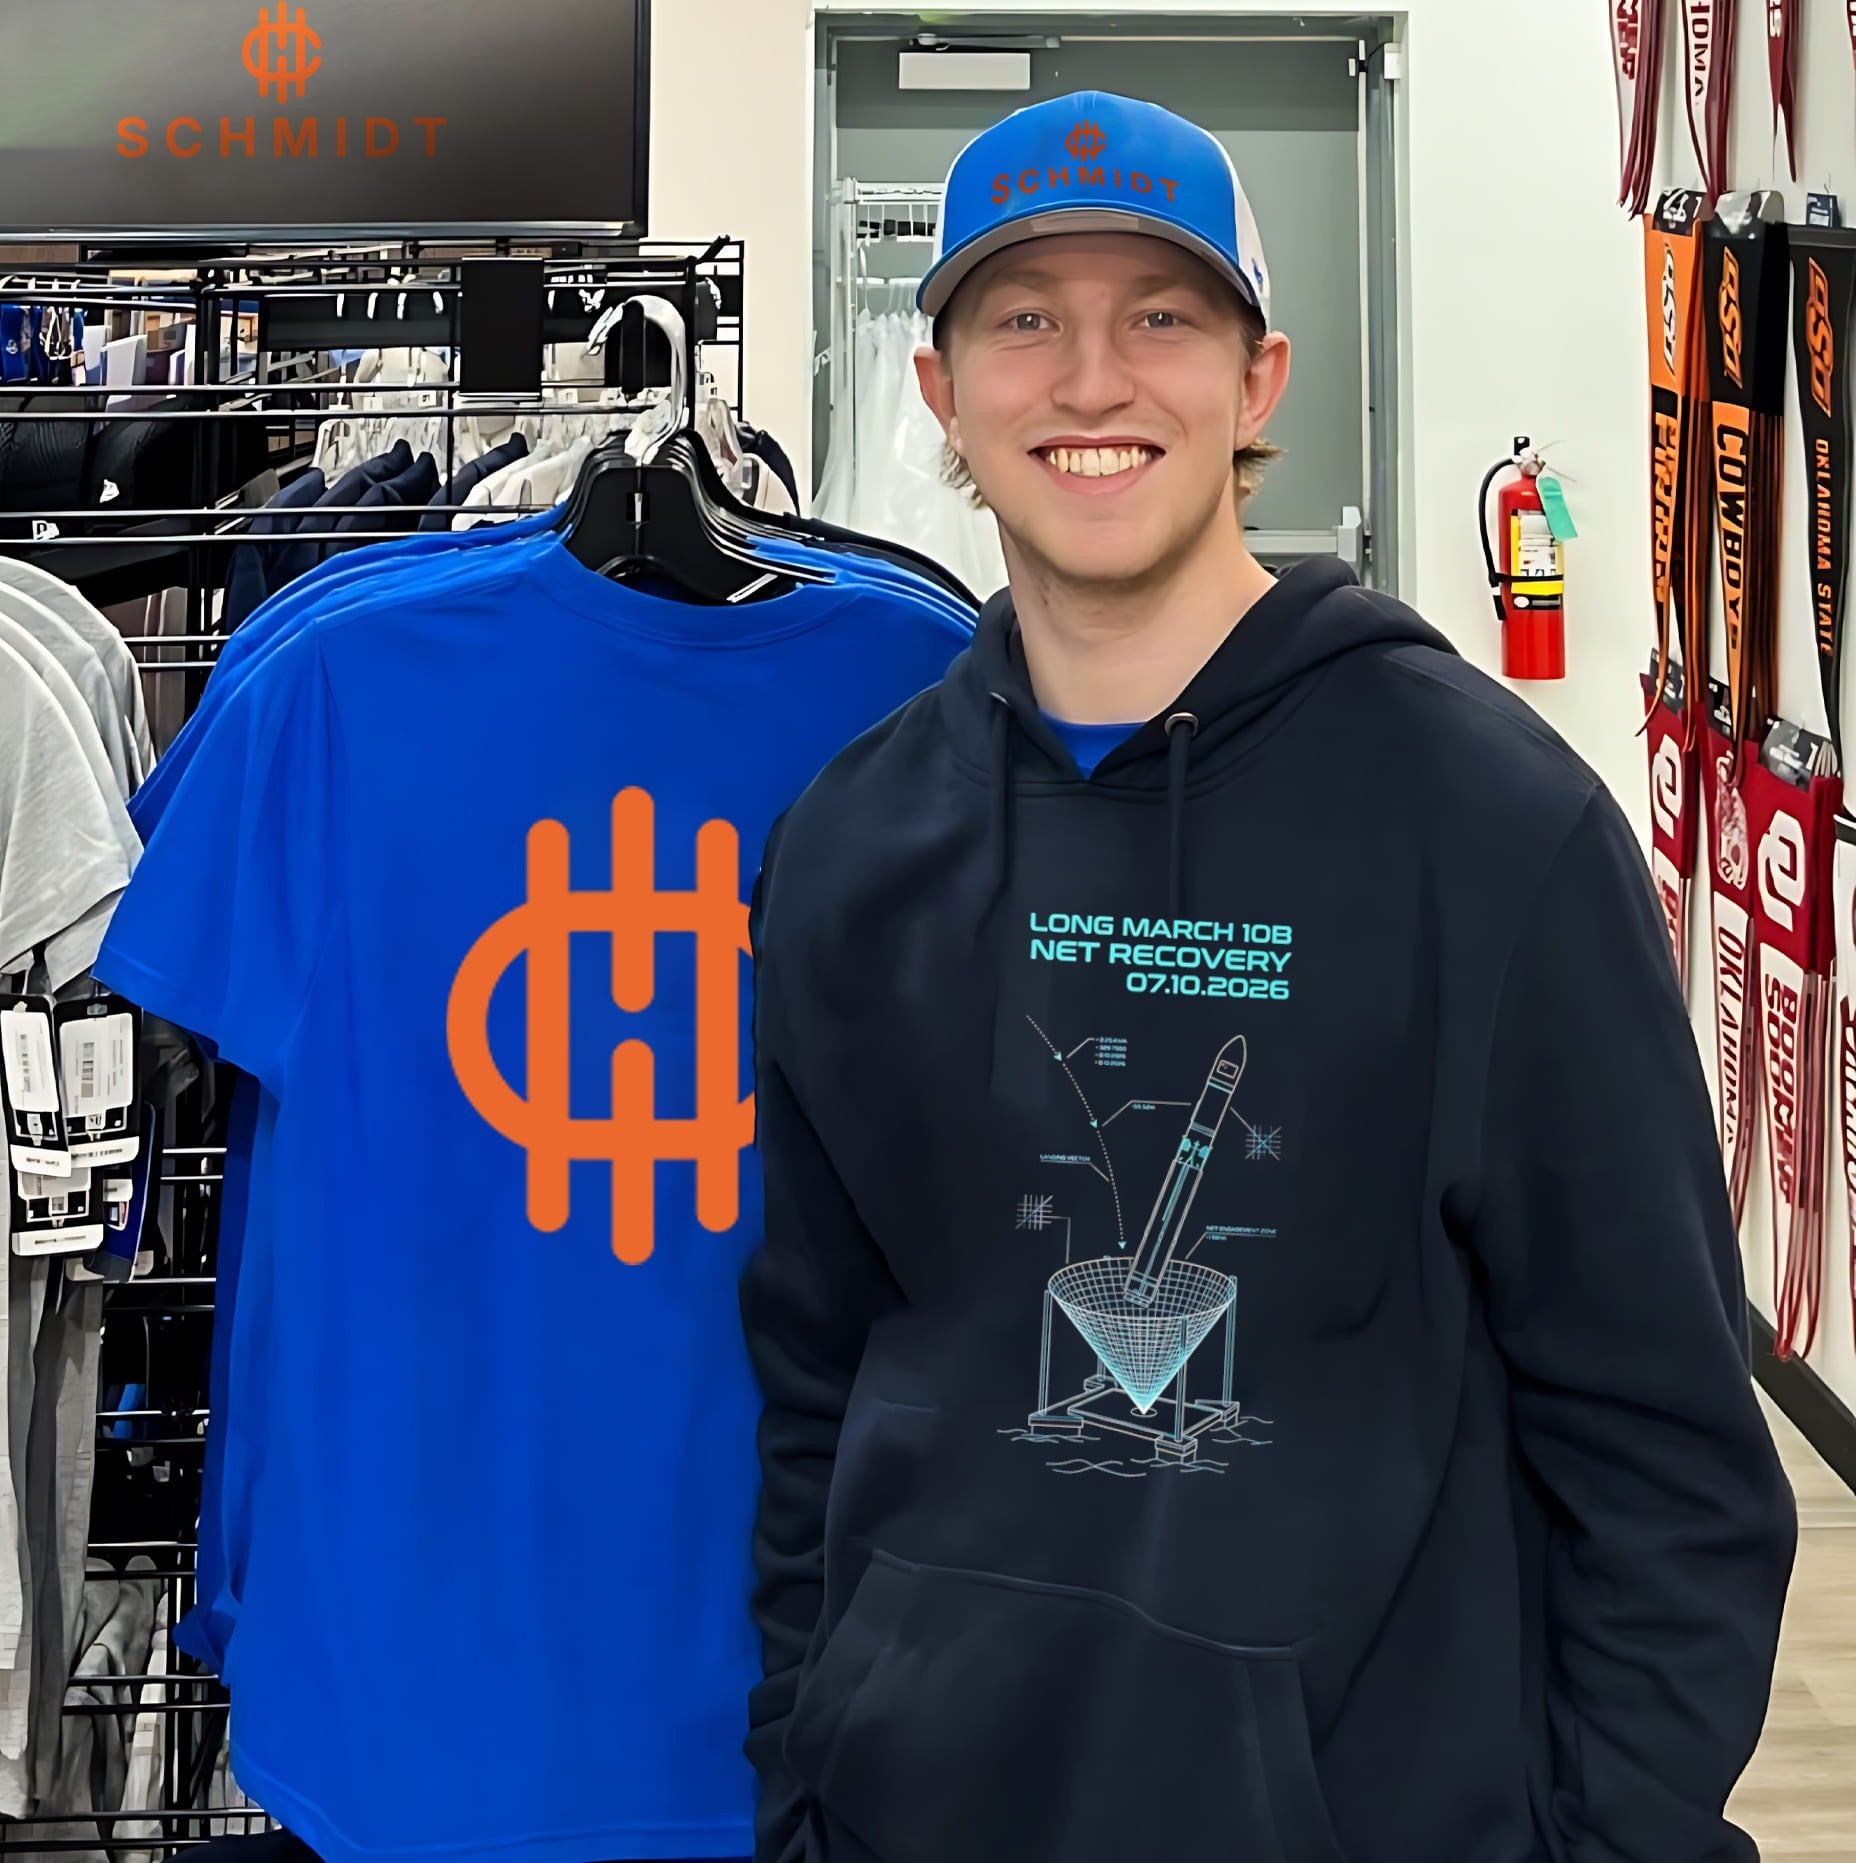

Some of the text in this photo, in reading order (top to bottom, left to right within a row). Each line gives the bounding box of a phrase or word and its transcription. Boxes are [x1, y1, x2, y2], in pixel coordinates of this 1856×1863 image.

[115, 117, 449, 158] SCHMIDT
[991, 167, 1179, 204] SCHMIDT
[1815, 439, 1832, 570] OKLAHOMA
[1030, 912, 1292, 945] LONG MARCH 10B
[1030, 939, 1292, 973] NET RECOVERY
[1126, 972, 1290, 1000] 07.10.2026
[1718, 926, 1745, 1144] OKLAHOMA
